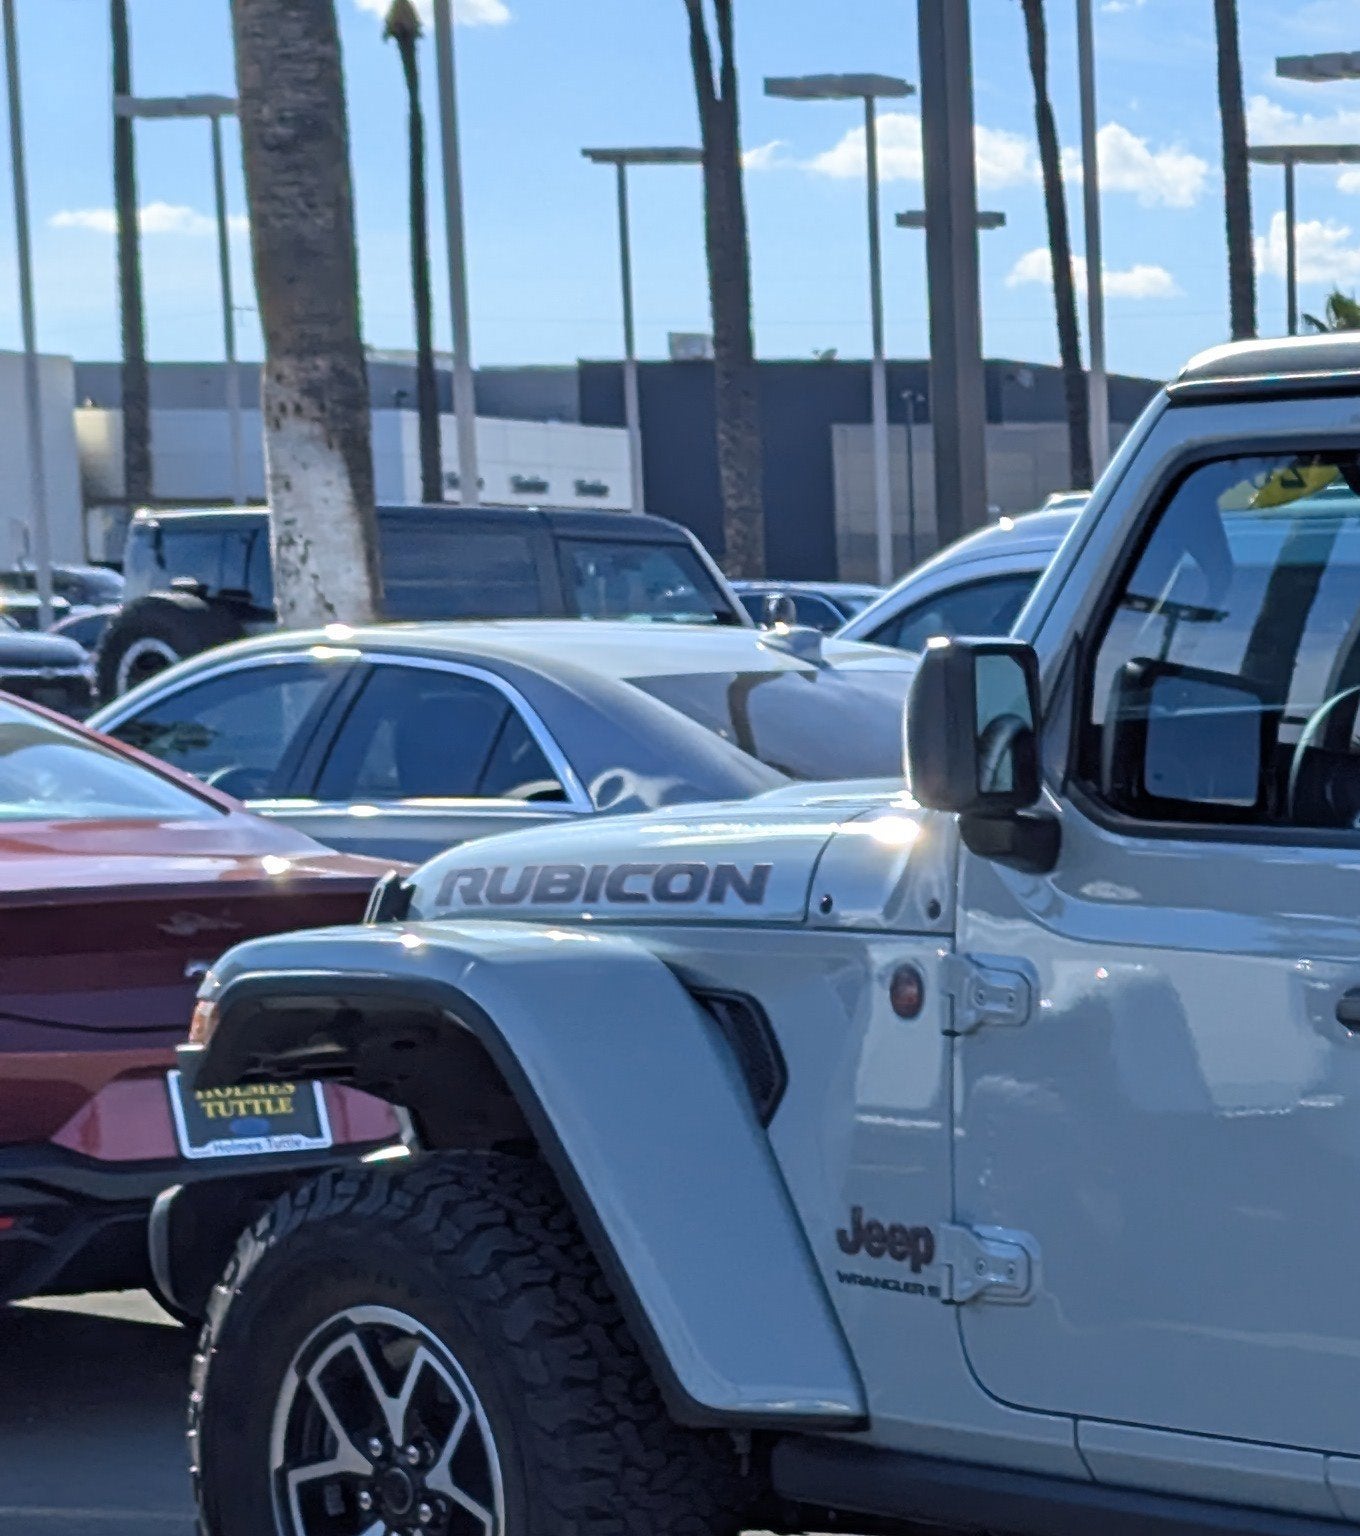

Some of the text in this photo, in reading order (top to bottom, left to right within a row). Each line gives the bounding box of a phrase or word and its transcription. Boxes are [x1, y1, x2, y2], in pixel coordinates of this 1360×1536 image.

[434, 862, 774, 905] RUBICON
[201, 1098, 294, 1119] TUTTLE
[836, 1205, 935, 1274] Jeep
[836, 1270, 925, 1296] WRANGLER
